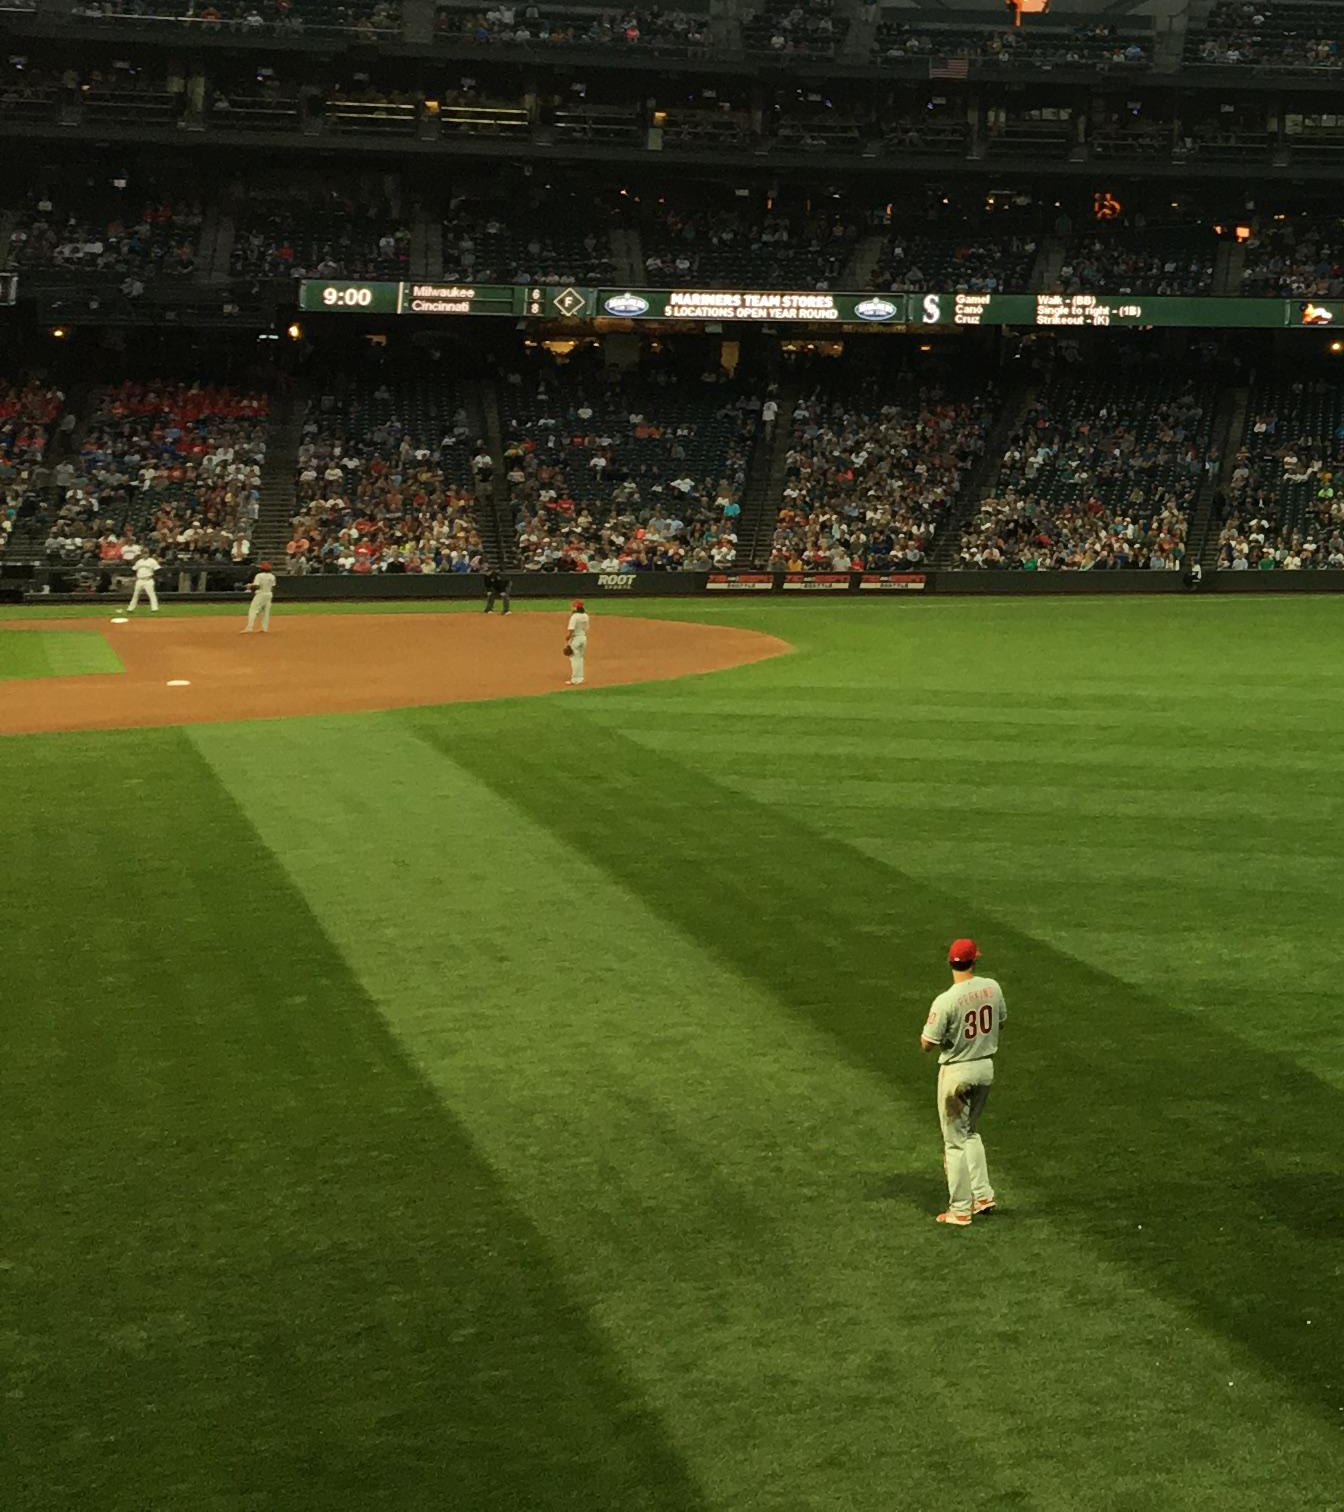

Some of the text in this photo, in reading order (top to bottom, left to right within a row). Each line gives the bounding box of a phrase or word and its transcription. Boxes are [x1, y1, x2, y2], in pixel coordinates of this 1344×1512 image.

[323, 288, 372, 305] 9:00
[413, 286, 475, 298] Milwaukee
[565, 297, 574, 308] F
[670, 293, 833, 308] MARINERS TEAM STORES
[955, 294, 991, 304] Gamel
[1037, 295, 1063, 304] Walk
[411, 300, 470, 313] Cincinnati
[665, 306, 838, 319] 5 LOCATIONS OPEN YEAR ROUND
[1037, 305, 1069, 317] Single
[1071, 307, 1083, 315] to
[1085, 306, 1110, 317] right
[954, 314, 980, 324] Cruz
[1036, 315, 1085, 325] Strikeout
[598, 575, 637, 585] ROOT
[964, 1004, 993, 1040] 30
